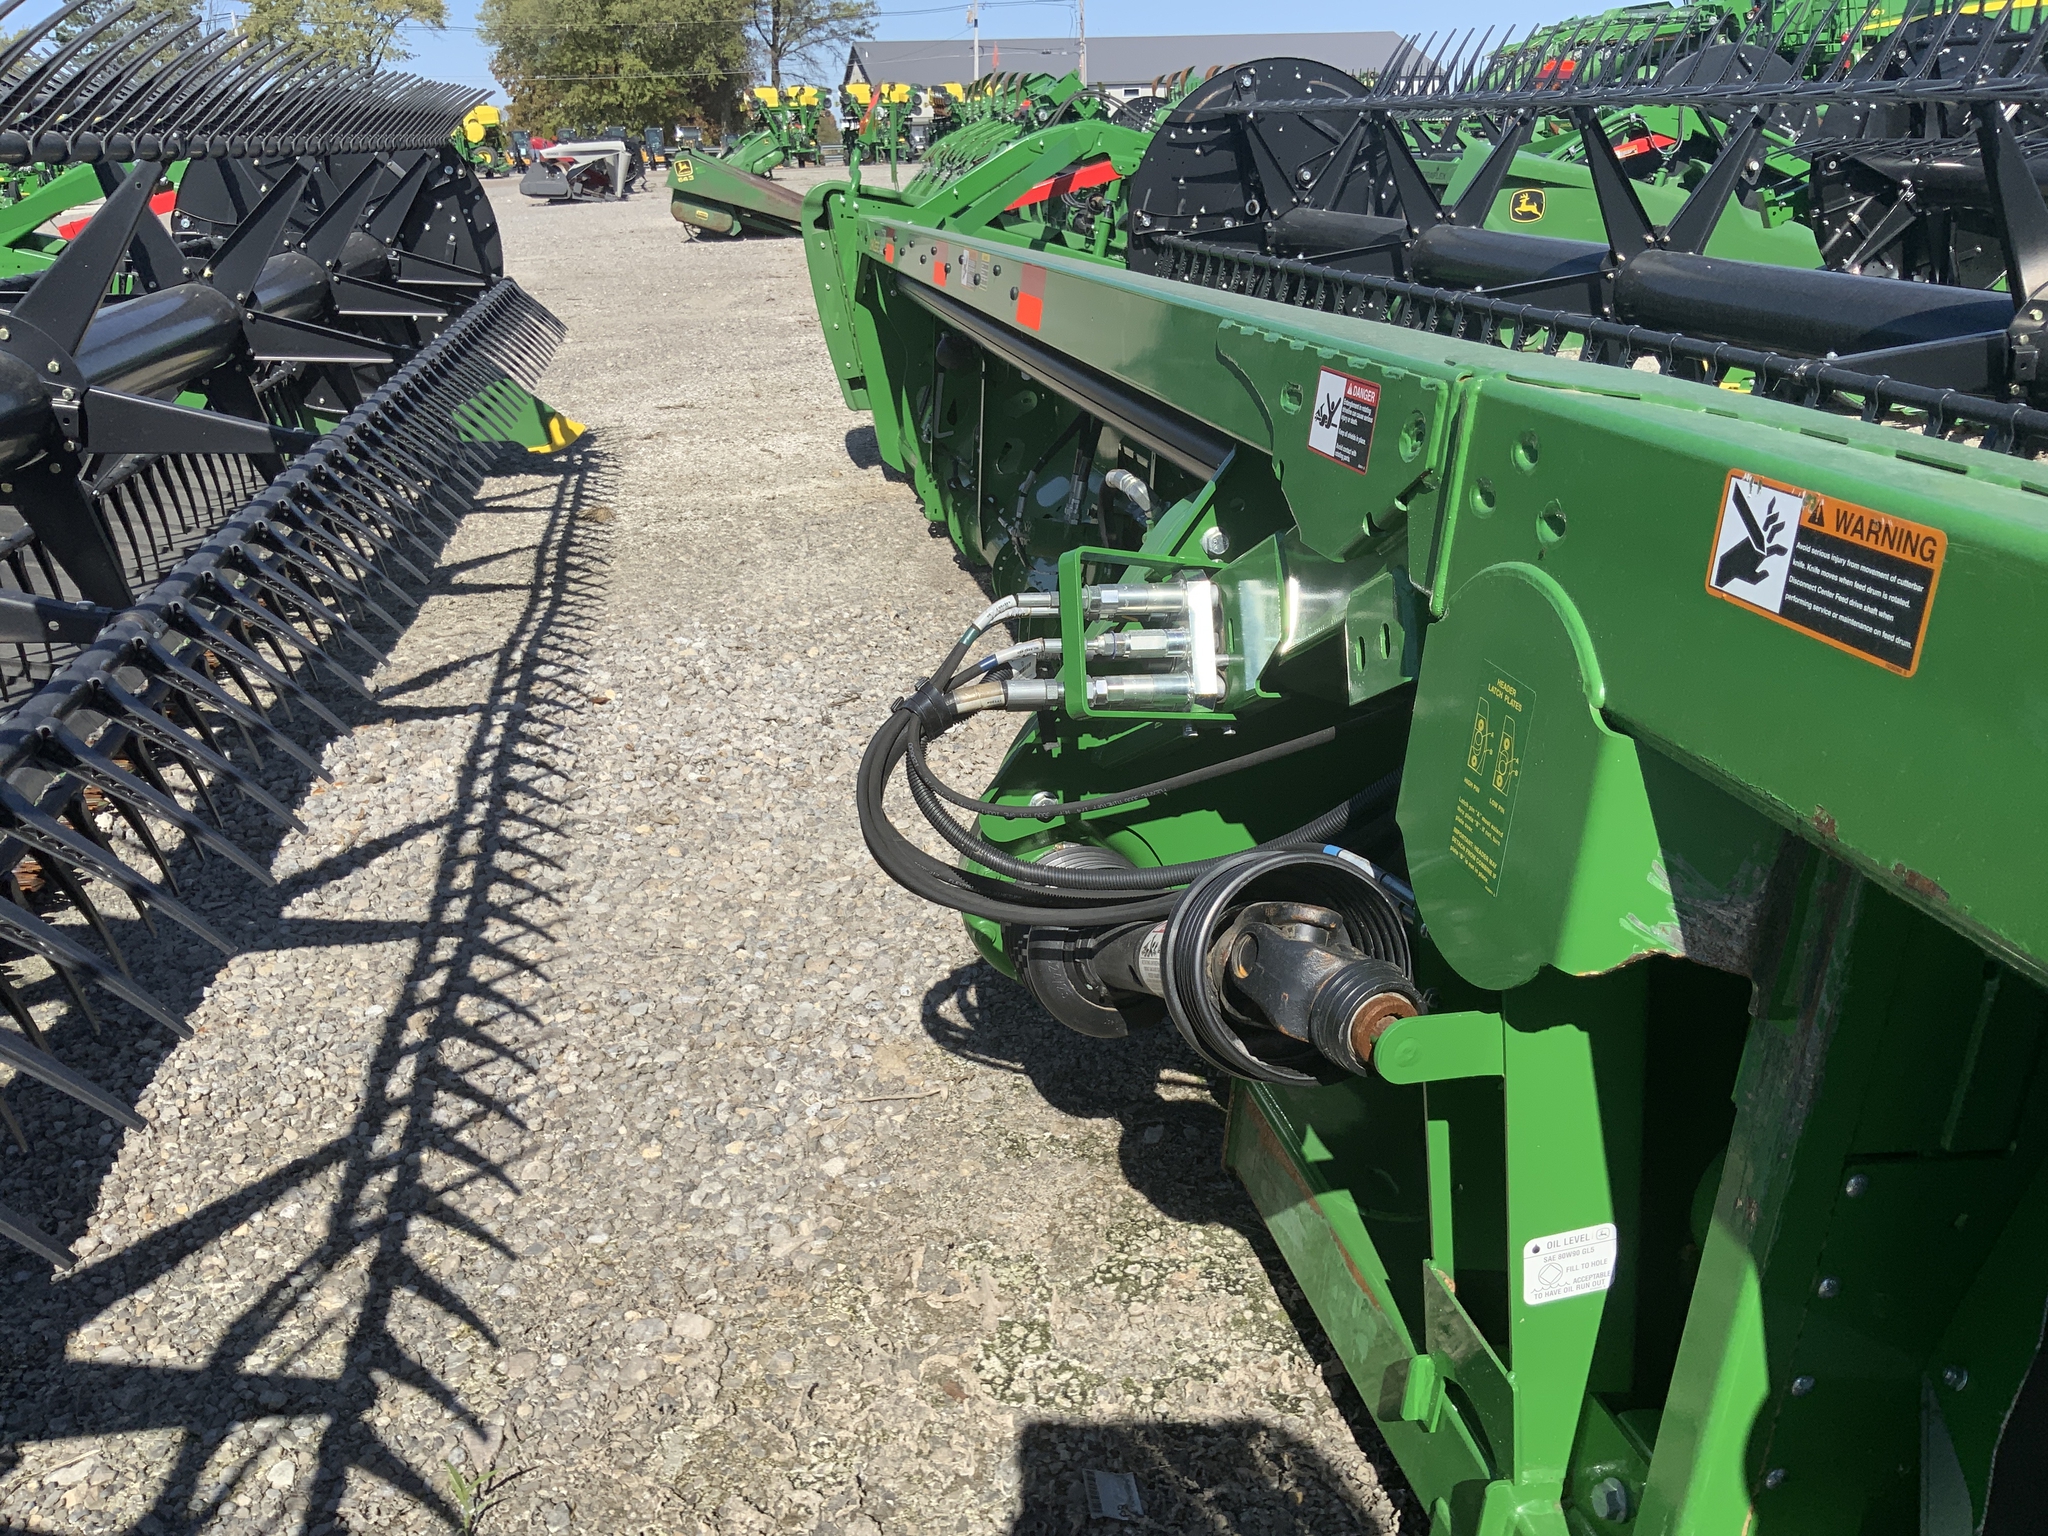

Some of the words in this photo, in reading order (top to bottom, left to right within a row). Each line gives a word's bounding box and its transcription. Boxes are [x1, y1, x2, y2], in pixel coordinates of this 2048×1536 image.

[1352, 386, 1376, 403] DANGER
[1834, 508, 1937, 563] WARNING
[1796, 542, 1810, 552] Avoid
[1811, 548, 1830, 559] serious
[1831, 554, 1846, 566] injury
[1847, 559, 1859, 569] from
[1860, 566, 1889, 580] movement
[1897, 579, 1923, 592] cutterbar
[1792, 558, 1805, 568] knife.
[1807, 564, 1820, 574] Knife
[1821, 570, 1838, 580] moves
[1839, 577, 1853, 586] when
[1854, 581, 1866, 591] feed
[1867, 586, 1881, 596] drum
[1882, 591, 1887, 599] is
[1889, 595, 1910, 607] rotated.
[1789, 576, 1816, 591] Disconnect
[1817, 587, 1834, 598] Center
[1835, 593, 1848, 603] Feed
[1849, 599, 1862, 609] drive
[1863, 605, 1878, 615] shaft
[1878, 611, 1893, 621] when
[1785, 594, 1812, 609] performing
[1813, 605, 1831, 616] service
[1839, 615, 1872, 632] maintenance
[1882, 631, 1895, 641] feed
[1895, 637, 1911, 648] drum.
[1497, 678, 1516, 697] HEADER
[1488, 684, 1503, 699] LATCH
[1504, 693, 1522, 712] PLATES
[1546, 1240, 1561, 1250] OIL
[1564, 1234, 1590, 1246] LEVEL
[1544, 1255, 1556, 1263] SAE
[1558, 1250, 1580, 1260] 80W90
[1582, 1246, 1594, 1254] GL5
[1591, 1258, 1608, 1266] HOLE
[1572, 1270, 1611, 1284] ACCEPTABLE
[1544, 1288, 1562, 1298] HAVE
[1576, 1282, 1590, 1290] RUN
[1592, 1279, 1606, 1287] OUT
